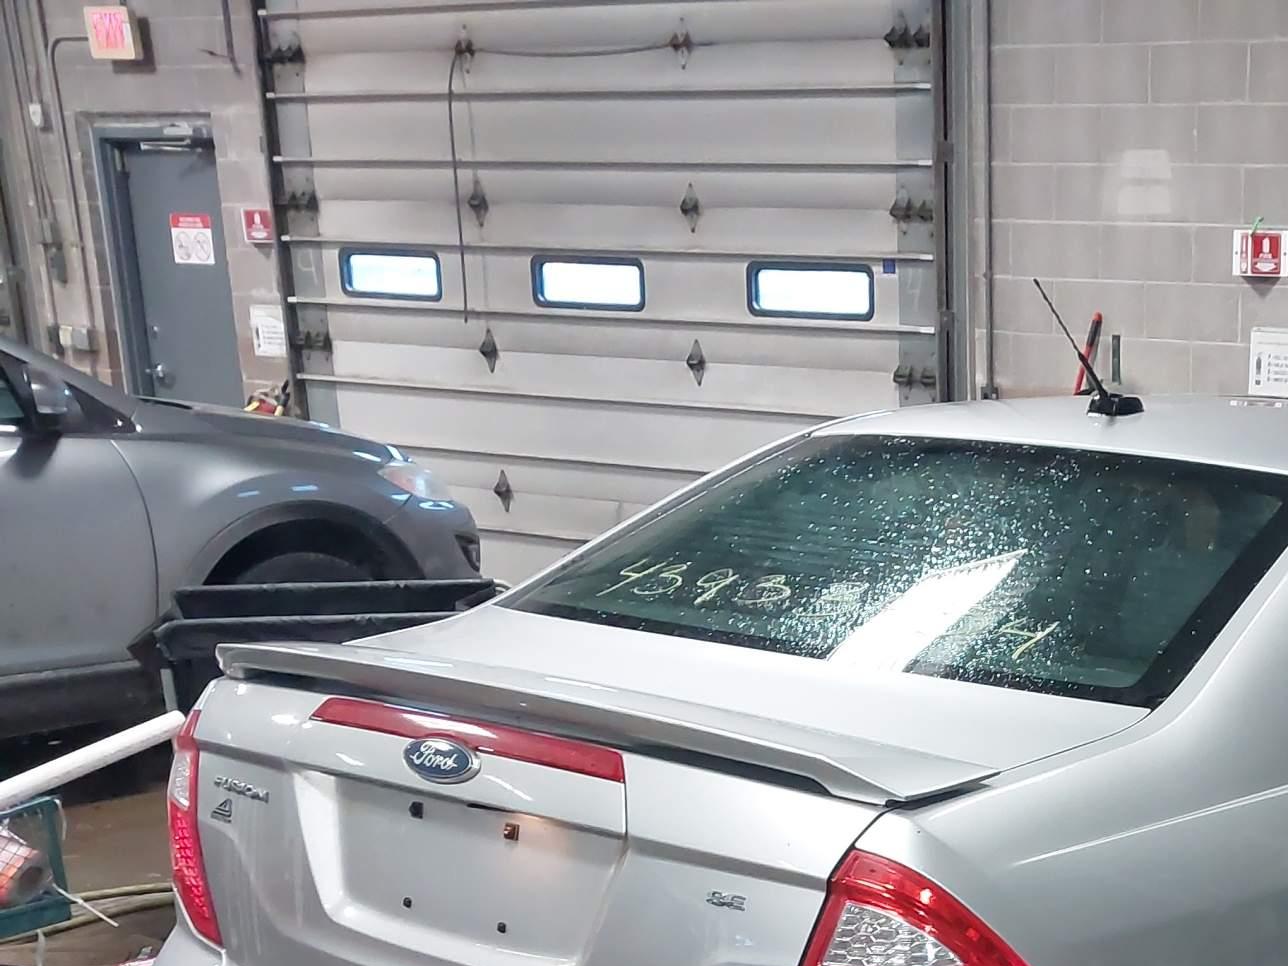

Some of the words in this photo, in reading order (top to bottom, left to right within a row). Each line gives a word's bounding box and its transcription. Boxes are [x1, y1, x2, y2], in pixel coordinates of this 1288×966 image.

[409, 741, 458, 771] Ford
[214, 776, 270, 804] FUSION
[706, 890, 747, 912] SE
